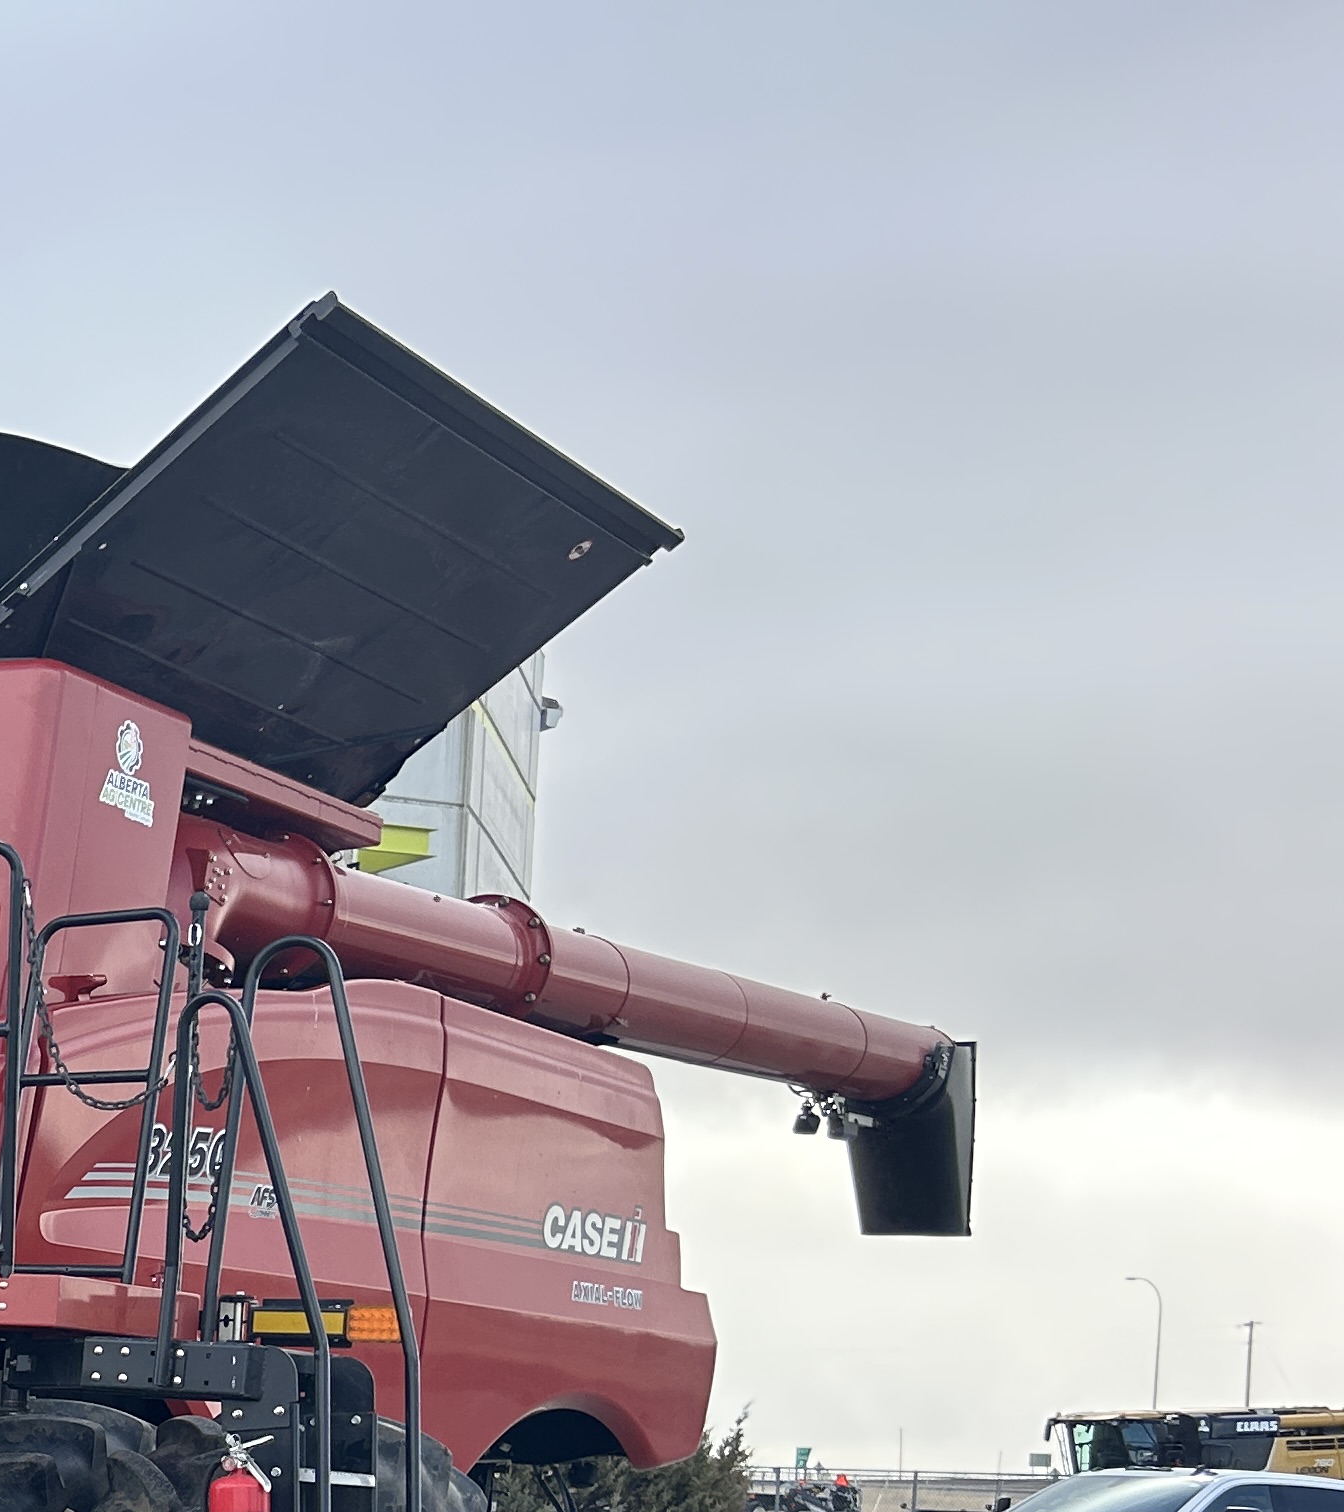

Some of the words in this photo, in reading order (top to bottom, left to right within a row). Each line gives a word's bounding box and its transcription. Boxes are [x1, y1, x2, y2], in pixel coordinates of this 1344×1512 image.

[107, 772, 149, 800] ALBERTA
[101, 787, 115, 802] AG
[117, 792, 152, 817] CENTRE
[250, 1184, 277, 1209] AFS
[543, 1204, 621, 1258] CASE
[572, 1280, 643, 1310] AXIAL-FLOW
[1236, 1420, 1279, 1432] CLAAS
